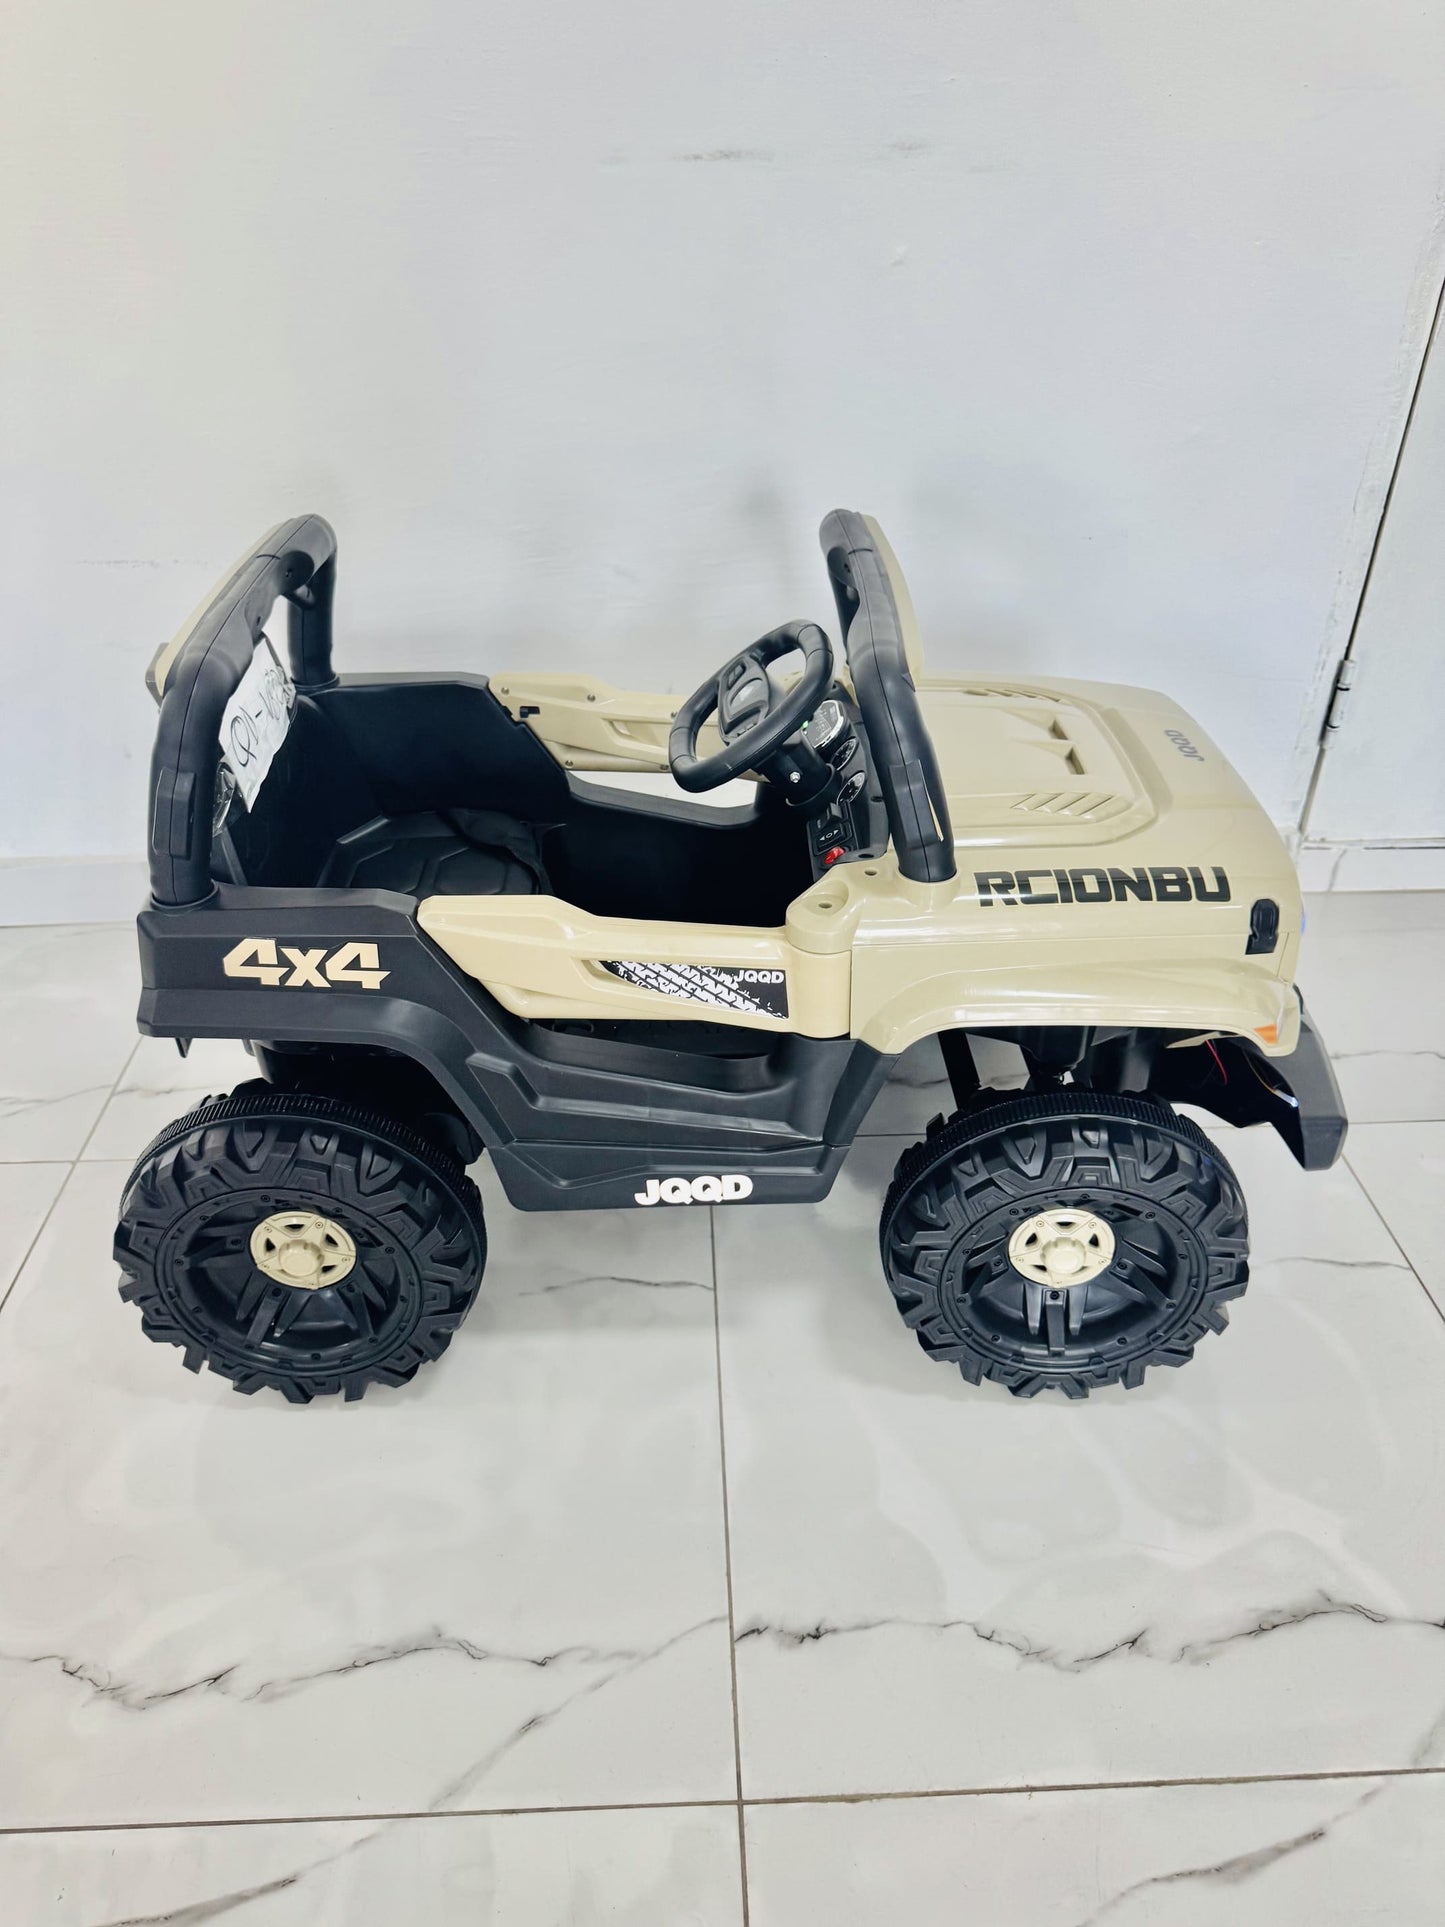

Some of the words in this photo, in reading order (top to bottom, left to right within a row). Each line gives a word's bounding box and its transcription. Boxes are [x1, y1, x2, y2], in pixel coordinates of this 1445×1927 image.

[1164, 730, 1205, 761] JQQD
[974, 867, 1231, 907] RCIONBU
[734, 970, 785, 984] JQQD
[634, 1174, 753, 1206] JQQD
